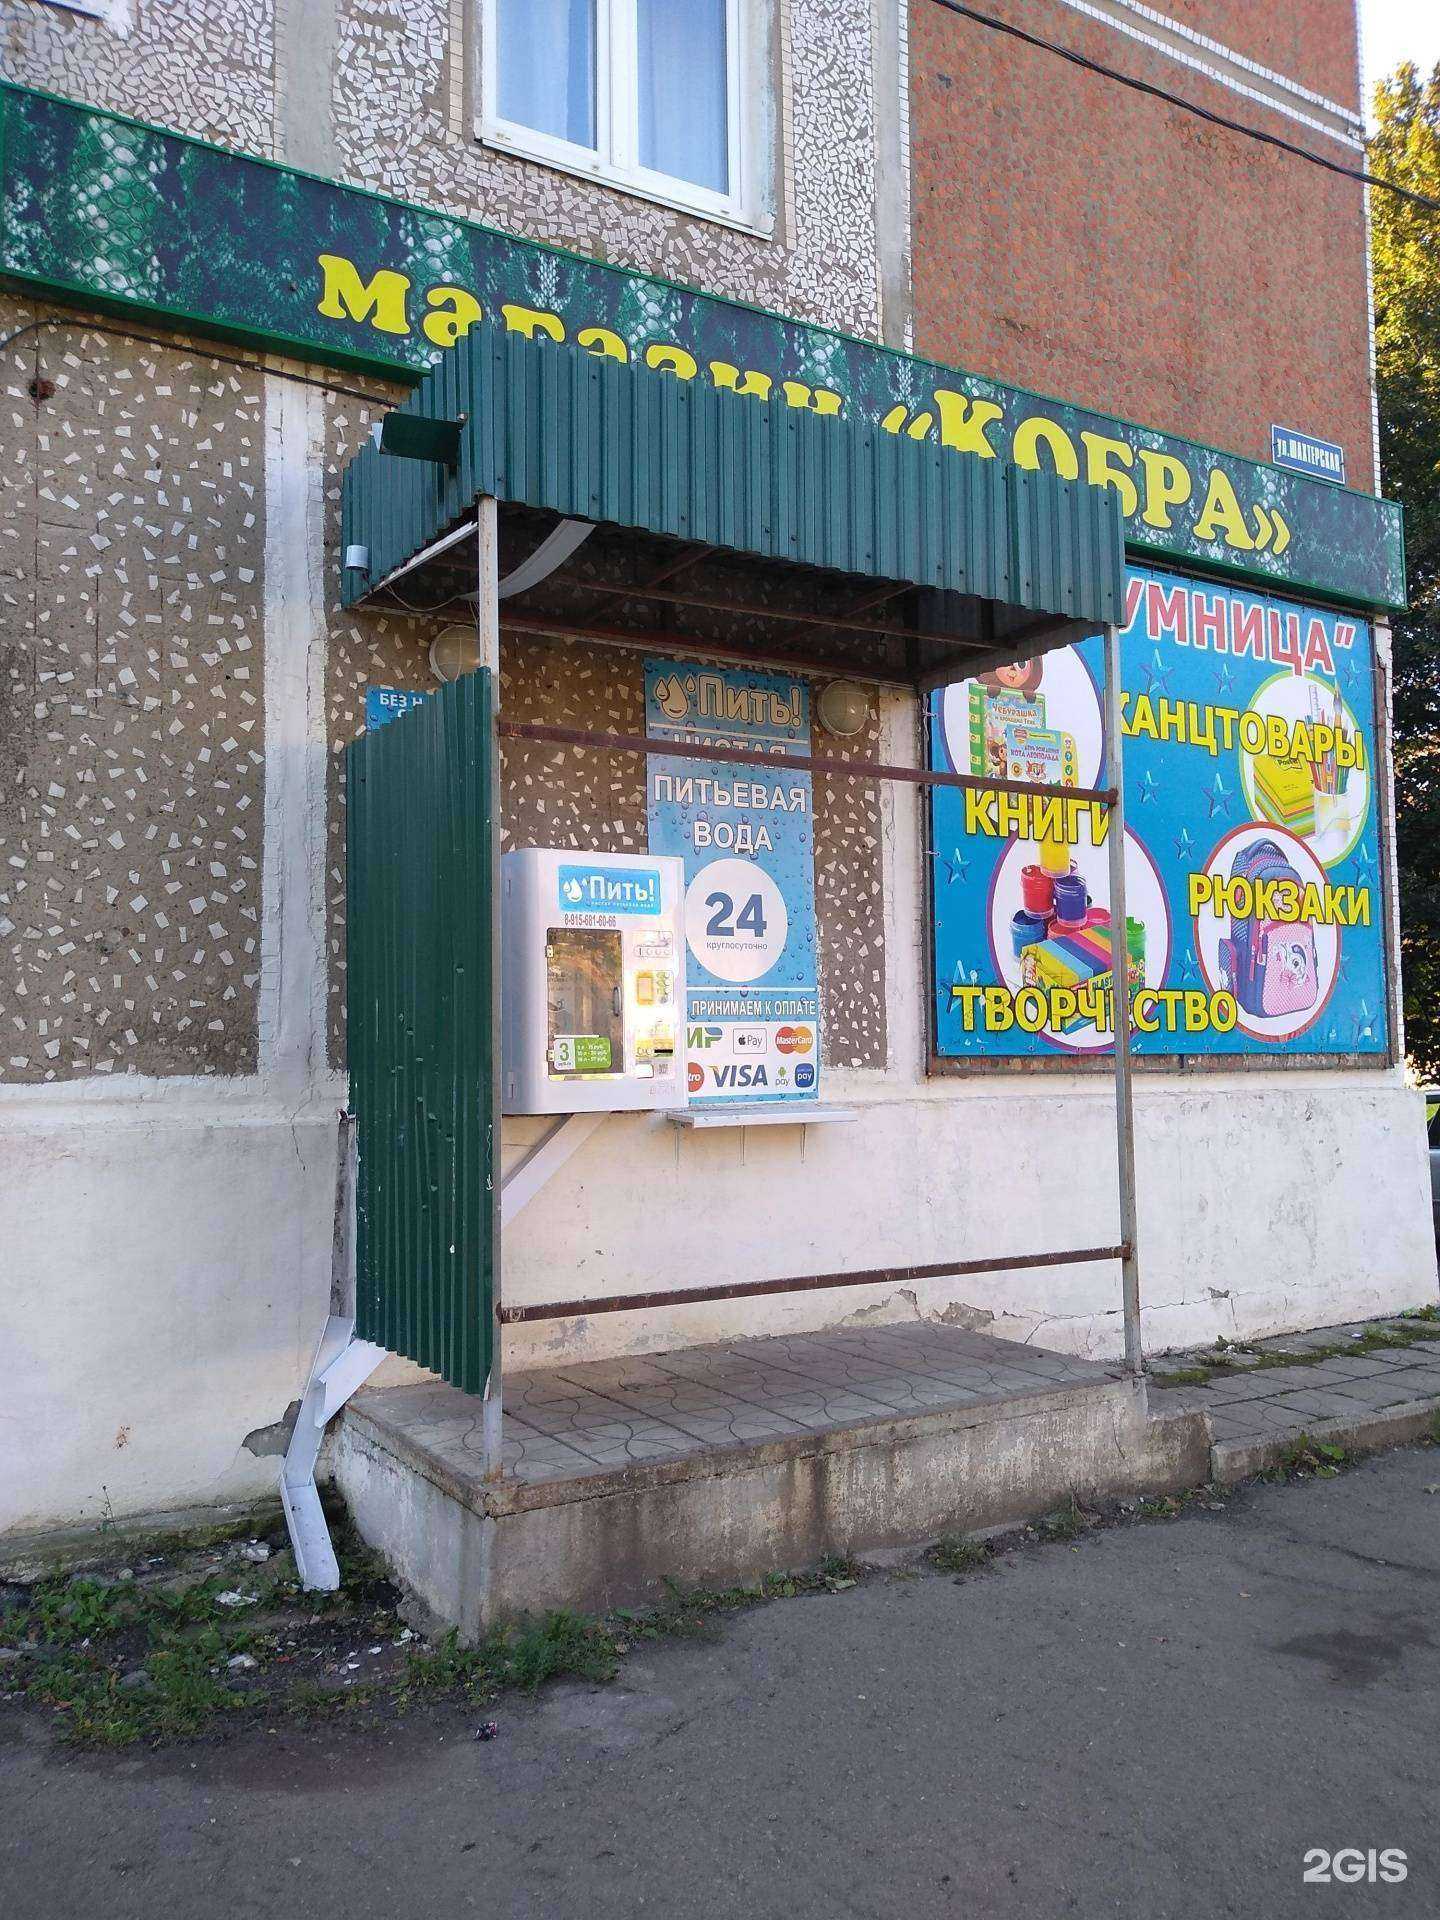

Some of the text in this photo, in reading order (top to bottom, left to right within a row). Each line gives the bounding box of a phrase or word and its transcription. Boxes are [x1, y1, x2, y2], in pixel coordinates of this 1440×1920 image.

[380, 693, 407, 708] БЕЗ
[699, 674, 801, 727] Пить!
[653, 774, 807, 813] ПИТЬЕВАЯ
[693, 820, 774, 855] ВОДА
[589, 875, 655, 902] Пить!
[1188, 873, 1371, 926] РЮКЗАКИ
[704, 891, 768, 937] 24
[706, 941, 768, 951] круглосуточно
[692, 1000, 817, 1016] ПРИНИМАЕМ К ОПЛАТЕ
[559, 1043, 569, 1061] 3
[747, 1035, 763, 1047] Pay
[707, 1064, 769, 1088] VISA
[797, 1073, 812, 1082] pay
